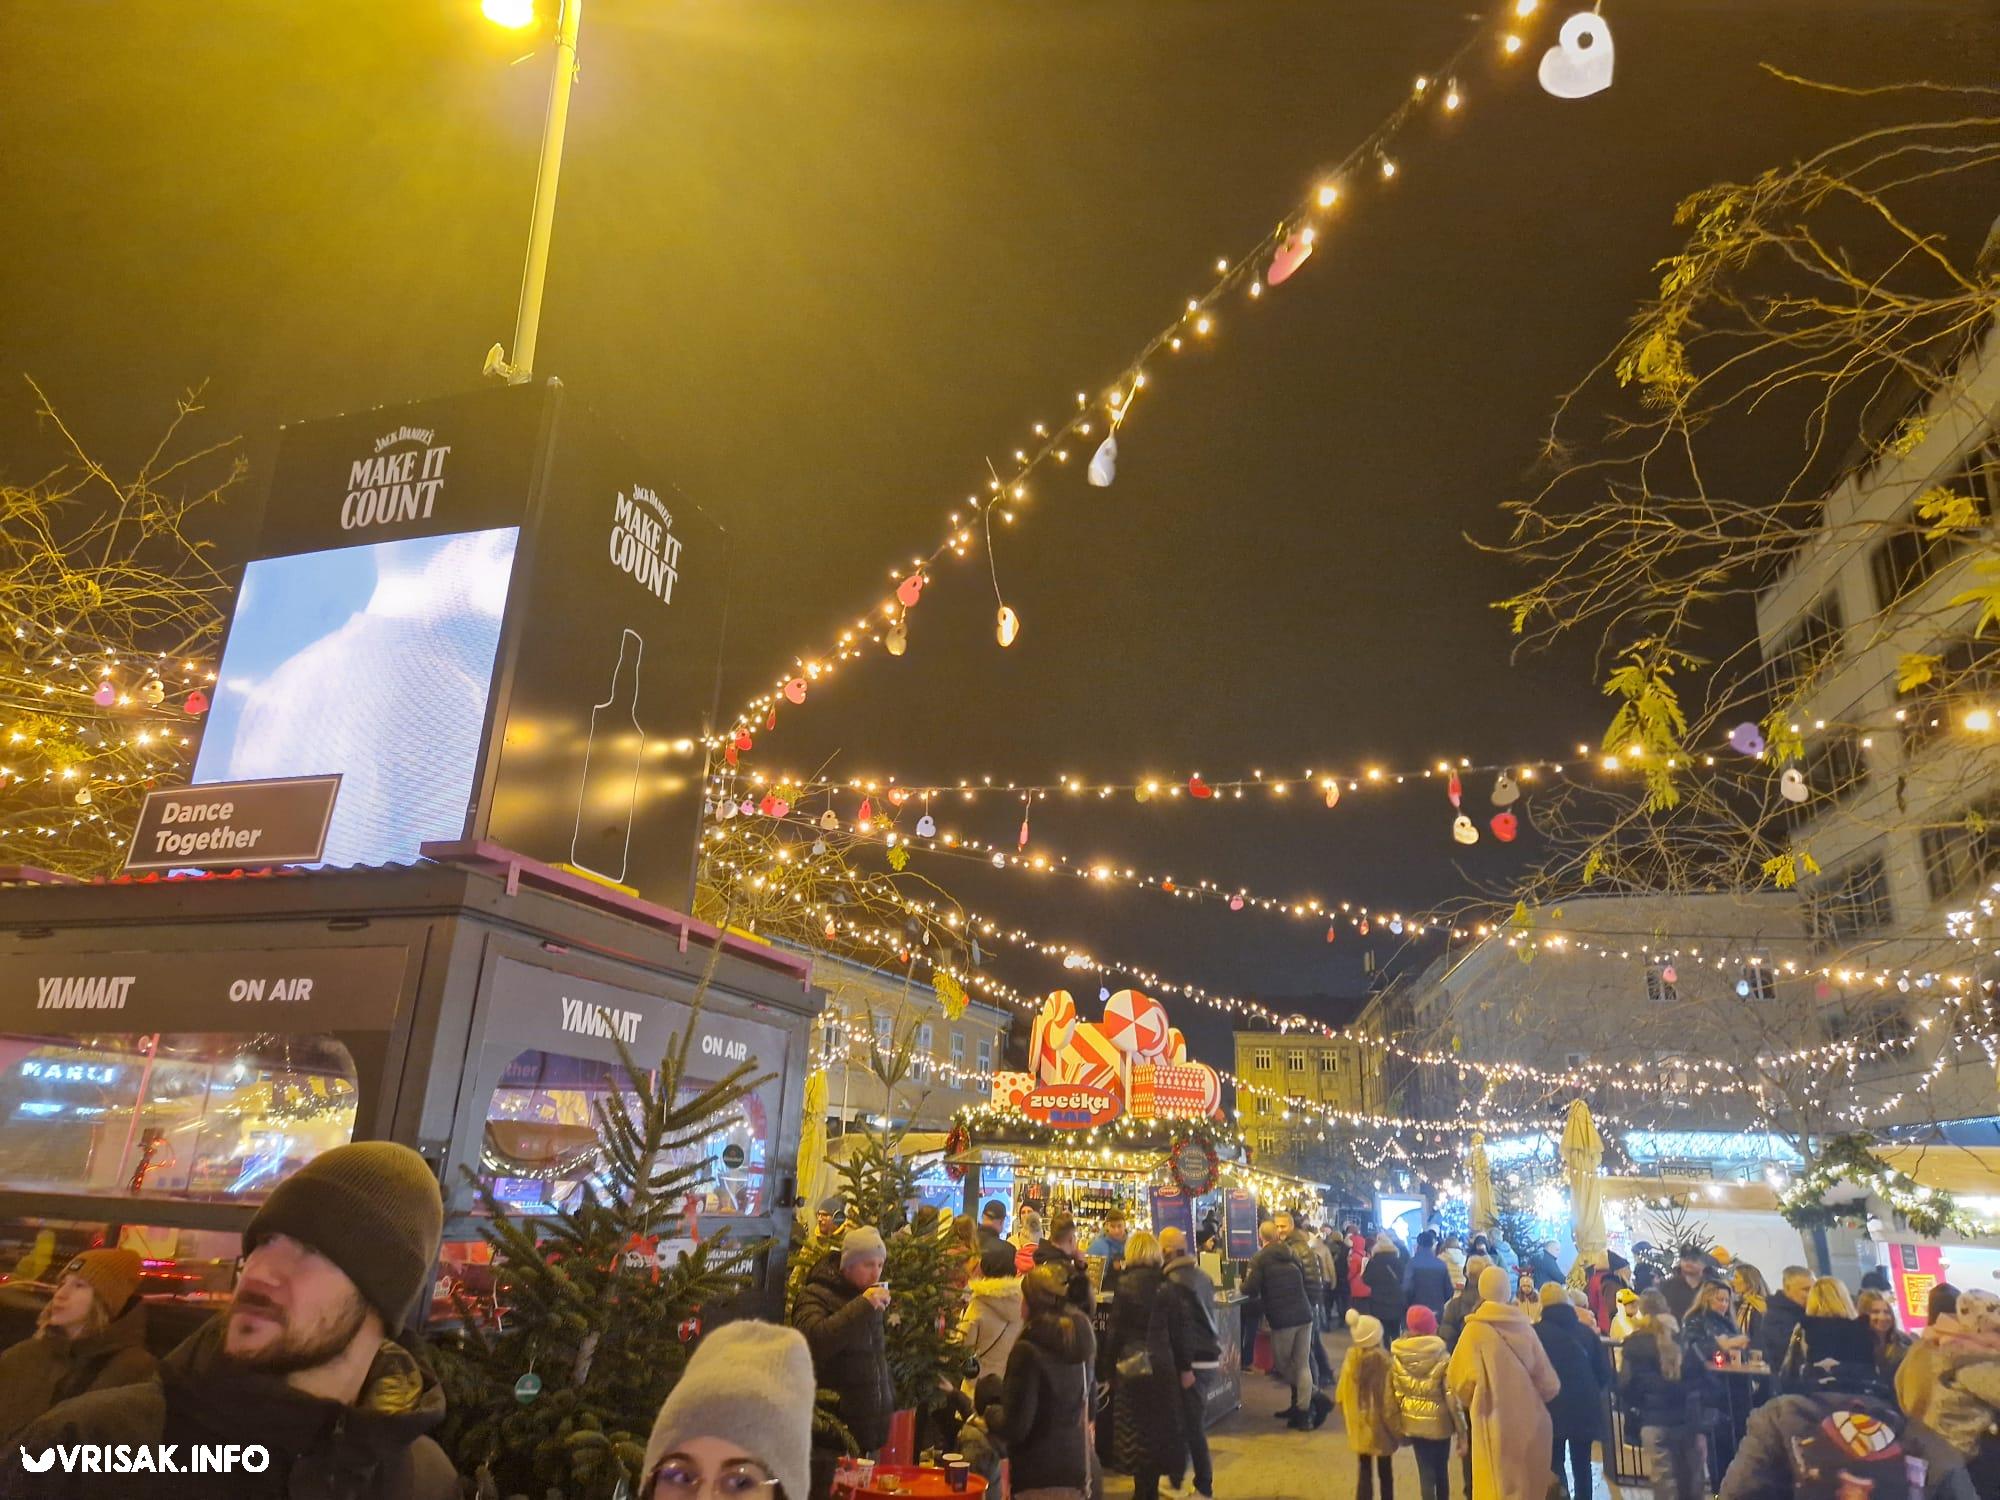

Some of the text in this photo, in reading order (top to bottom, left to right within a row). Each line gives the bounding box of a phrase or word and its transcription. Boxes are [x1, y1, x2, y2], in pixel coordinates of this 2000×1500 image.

[347, 446, 451, 491] MAKE IT
[341, 479, 444, 530] COUNT
[614, 491, 682, 569] MAKE IT
[609, 526, 678, 605] COUNT
[161, 802, 234, 824] Dance
[155, 826, 262, 856] Together
[36, 976, 136, 1009] YAMMAT
[229, 978, 313, 1001] ON AIR
[701, 1035, 748, 1062] ON AIR
[1030, 1092, 1110, 1115] zvečka
